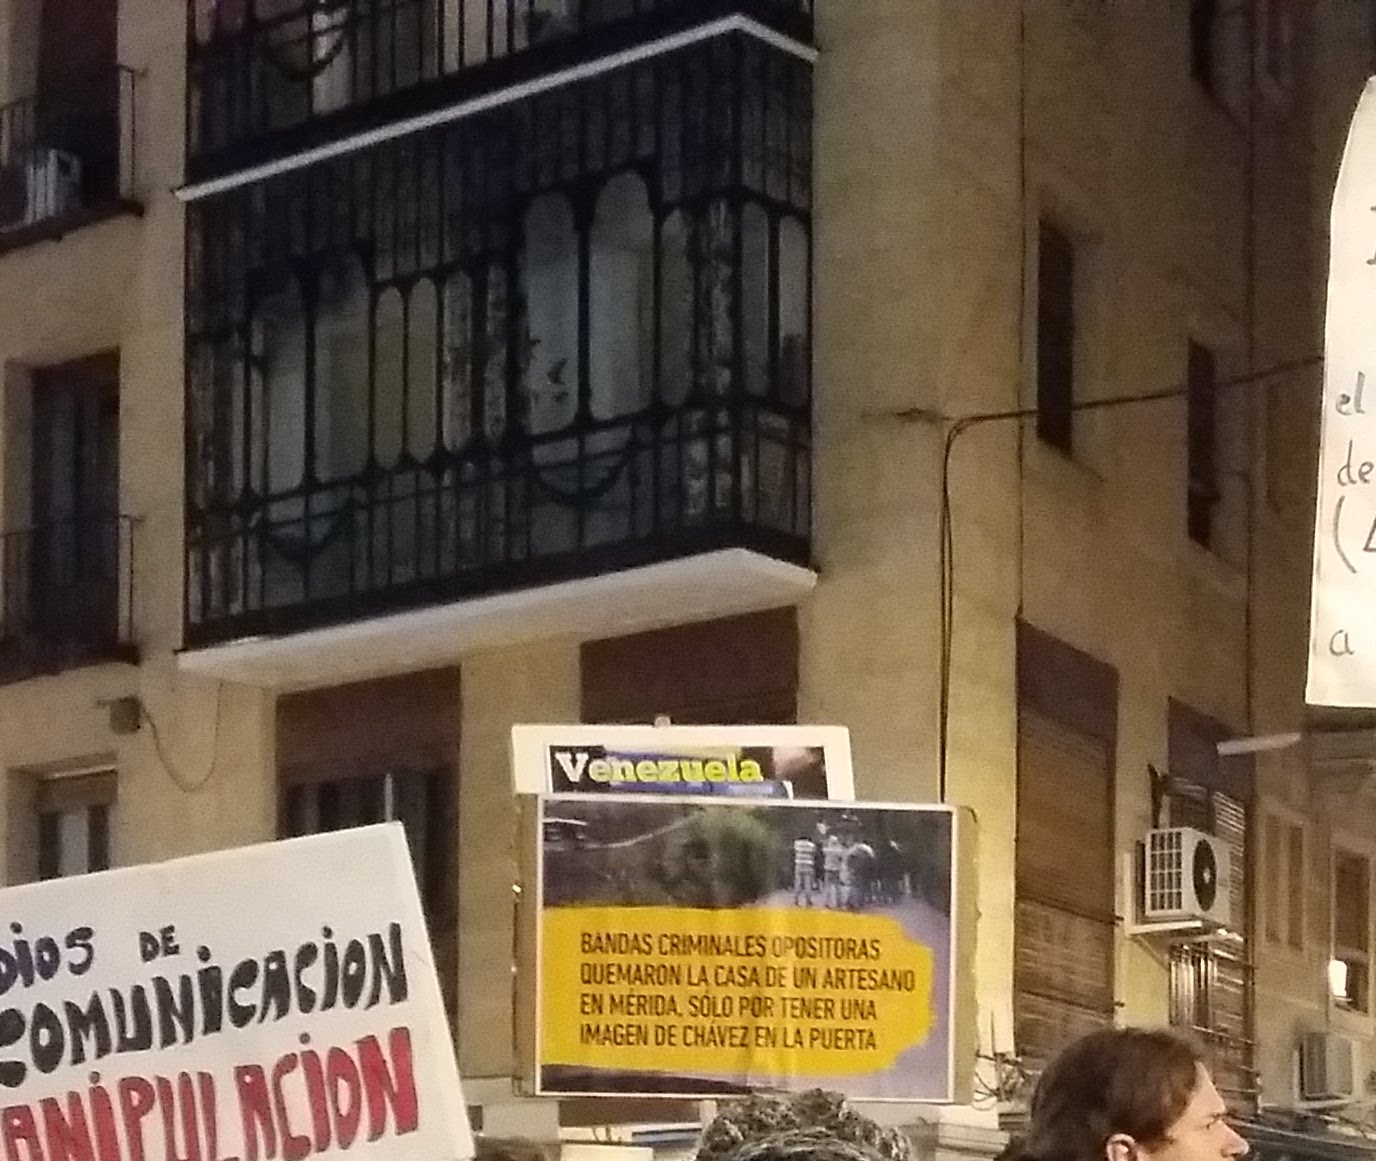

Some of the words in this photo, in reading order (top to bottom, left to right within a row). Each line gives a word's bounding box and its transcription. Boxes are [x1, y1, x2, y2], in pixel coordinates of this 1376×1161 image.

[1335, 371, 1365, 415] el
[1337, 440, 1373, 487] de
[1329, 628, 1354, 657] a
[554, 751, 765, 784] Venezuela
[138, 924, 181, 963] DE
[580, 932, 653, 955] BANDAS
[658, 934, 767, 958] CRIMINALES
[772, 937, 881, 961] OPOSITORAS
[580, 962, 682, 986] QUEMARON
[687, 965, 711, 987] LA
[713, 965, 761, 988] CASA
[765, 966, 787, 988] DE
[792, 967, 818, 989] UN
[821, 968, 916, 992] ARTESANO
[580, 993, 604, 1015] EN
[687, 989, 734, 1018] SÓLO
[738, 996, 774, 1018] POR
[780, 997, 835, 1020] TENER
[840, 998, 877, 1021] UNA
[580, 1023, 649, 1046] IMAGEN
[654, 1024, 677, 1047] DE
[682, 1019, 750, 1048] CHÁVEZ
[755, 1026, 777, 1049] EN
[782, 1026, 804, 1049] LA
[809, 1027, 877, 1051] PUERTA
